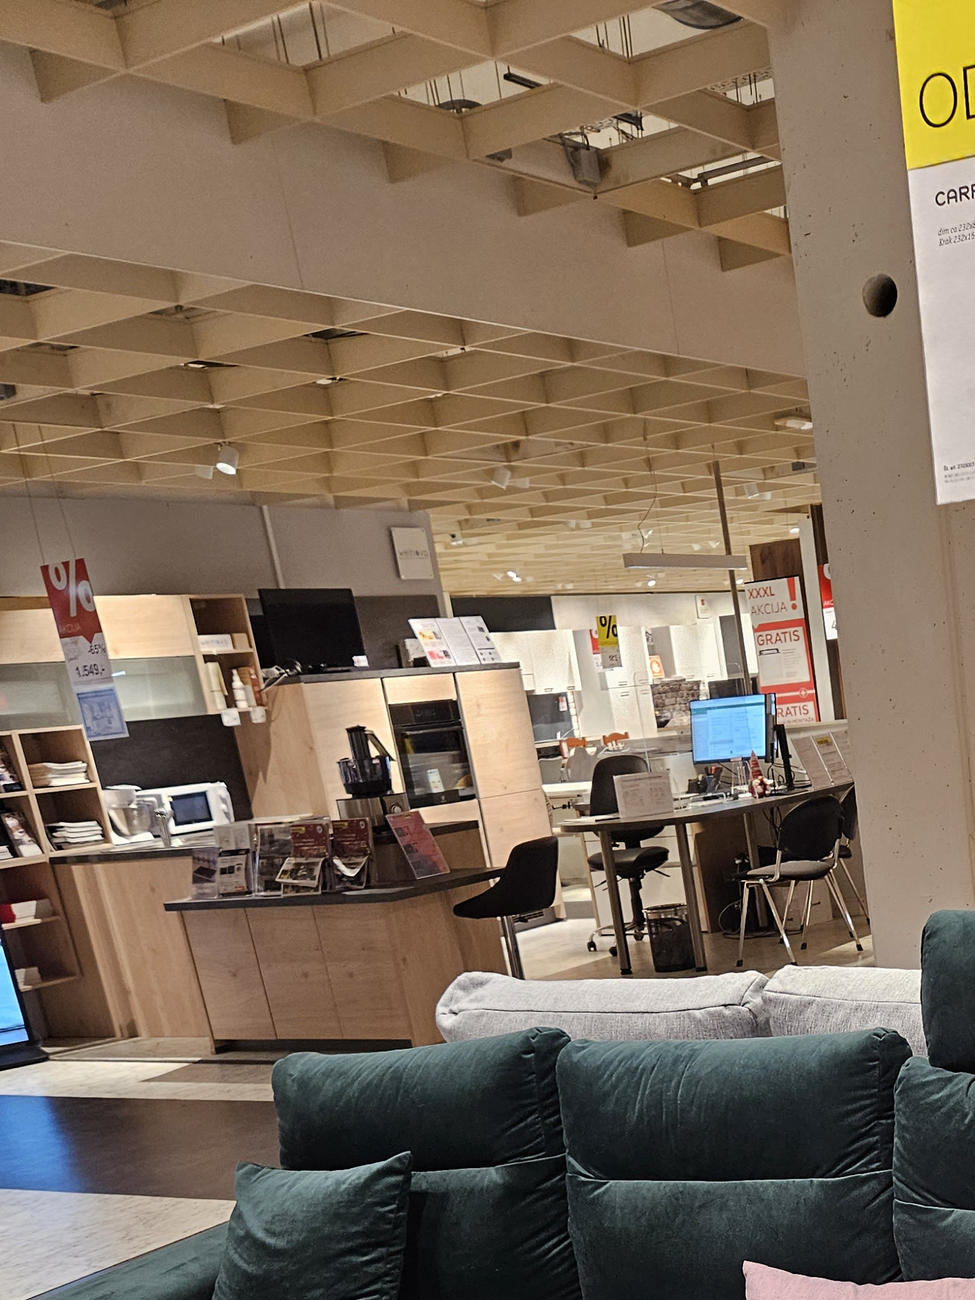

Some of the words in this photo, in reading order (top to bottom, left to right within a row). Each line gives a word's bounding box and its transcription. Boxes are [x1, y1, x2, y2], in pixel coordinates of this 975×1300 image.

[747, 586, 775, 600] XXXL
[751, 601, 788, 615] AKCIJA
[756, 630, 801, 646] GRATIS
[776, 703, 809, 718] RATIS
